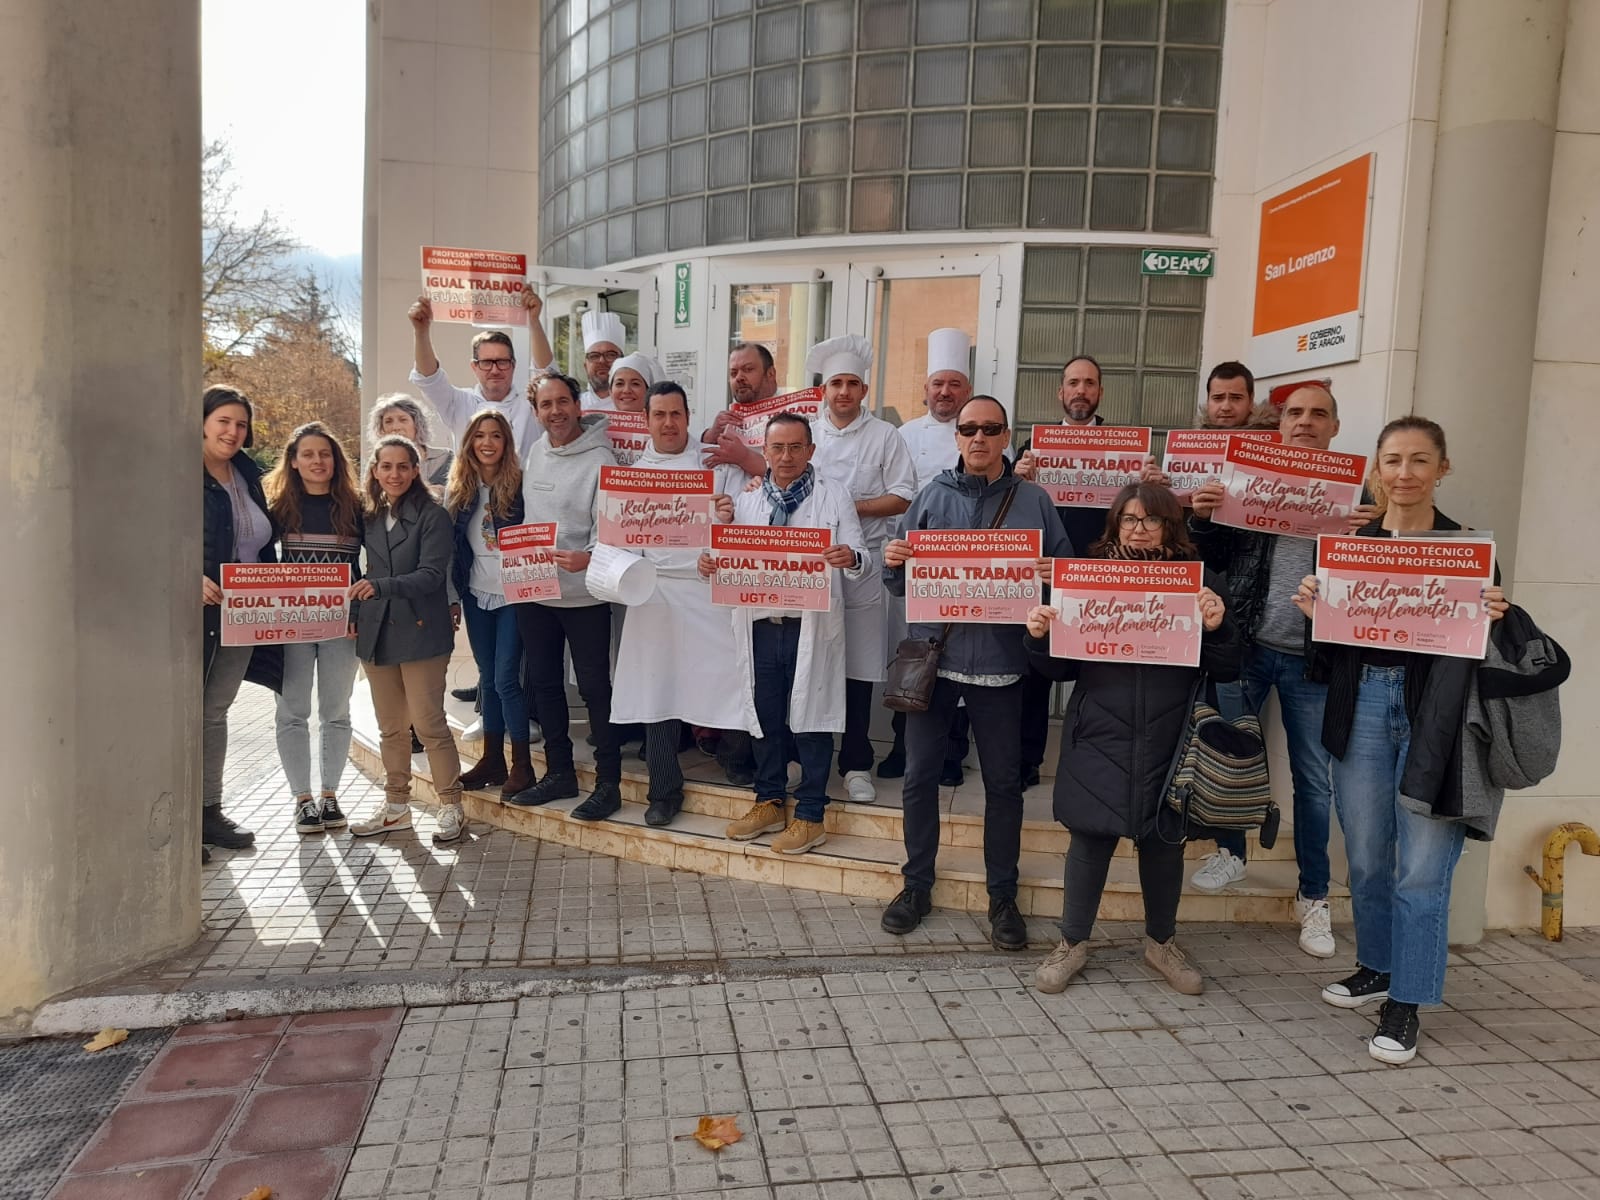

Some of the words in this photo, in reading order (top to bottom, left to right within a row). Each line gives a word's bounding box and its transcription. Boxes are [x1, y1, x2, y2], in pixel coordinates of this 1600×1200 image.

[432, 250, 485, 260] PROFESORADO
[487, 253, 517, 262] TÉCNICO
[428, 258, 472, 266] FORMACIÓN
[473, 261, 522, 270] PROFESIONAL
[1158, 256, 1191, 270] DEA
[1264, 263, 1285, 281] San
[1288, 245, 1336, 274] Lorenzo
[426, 276, 464, 288] IGUAL
[469, 280, 522, 294] TRABAJO
[449, 309, 472, 319] UGT
[1309, 341, 1317, 350] DE
[1044, 429, 1101, 437] PROFESORADO
[1104, 429, 1138, 438] TÉCNICO
[1039, 436, 1087, 445] FORMACIÓN
[1088, 438, 1143, 446] PROFESIONAL
[1172, 441, 1218, 449] FORMACIÓN
[1241, 442, 1308, 460] PROFESORADO
[1311, 452, 1353, 466] TÉCNICO
[1035, 456, 1076, 468] IGUAL
[1080, 458, 1142, 473] TRABAJO
[1168, 462, 1208, 473] IGUAL
[1234, 450, 1290, 467] FORMACIÓN
[1291, 461, 1357, 477] PROFESIONAL
[610, 470, 668, 479] PROFESORADO
[671, 472, 704, 480] TÉCNICO
[605, 478, 654, 487] FORMACIÓN
[656, 481, 708, 489] PROFESIONAL
[1245, 476, 1306, 497] ¡Reclama
[1309, 482, 1327, 496] tu
[1057, 491, 1082, 502] UGT
[620, 498, 672, 516] ¡Reclama
[674, 496, 687, 509] tu
[1242, 494, 1334, 515] complemento!
[620, 511, 694, 531] complemento!
[1245, 515, 1276, 529] UGT
[626, 534, 651, 544] UGT
[723, 528, 782, 537] PROFESORADO
[785, 530, 820, 538] TÉCNICO
[988, 532, 1027, 541] TÉCNICO
[718, 536, 767, 545] FORMACIÓN
[770, 539, 824, 548] PROFESIONAL
[913, 542, 968, 552] FORMACIÓN
[1334, 542, 1417, 555] PROFESORADO
[1421, 545, 1474, 557] TÉCNICO
[503, 554, 522, 568] IGUAL
[715, 557, 758, 570] IGUAL
[762, 559, 825, 574] TRABAJO
[1327, 553, 1395, 565] FORMACIÓN
[1398, 557, 1482, 569] PROFESIONAL
[302, 565, 338, 573] TÉCNICO
[912, 566, 959, 580] IGUAL
[963, 567, 1034, 582] TRABAJO
[1068, 564, 1140, 574] PROFESORADO
[1142, 565, 1187, 574] TÉCNICO
[230, 575, 283, 583] FORMACIÓN
[286, 575, 343, 583] PROFESIONAL
[716, 572, 760, 586] IGUAL
[764, 576, 826, 589] SALARIO
[1061, 574, 1121, 584] FORMACIÓN
[1124, 576, 1194, 586] PROFESIONAL
[517, 587, 532, 598] UGT
[912, 585, 961, 598] IGUAL
[966, 585, 1035, 599] SALARIO
[1347, 578, 1423, 602] ¡Reclama
[1425, 578, 1448, 599] tu
[228, 596, 275, 608] IGUAL
[278, 595, 344, 608] TRABAJO
[740, 593, 766, 603] UGT
[940, 606, 968, 616] UGT
[1079, 596, 1144, 619] ¡Reclama
[1146, 594, 1165, 610] tu
[1347, 598, 1458, 624] complemento!
[228, 612, 276, 625] IGUAL
[281, 610, 344, 623] SALARIO
[1080, 614, 1174, 639] complemento!
[255, 630, 282, 640] UGT
[1354, 626, 1390, 641] UGT
[1086, 642, 1118, 655] UGT
